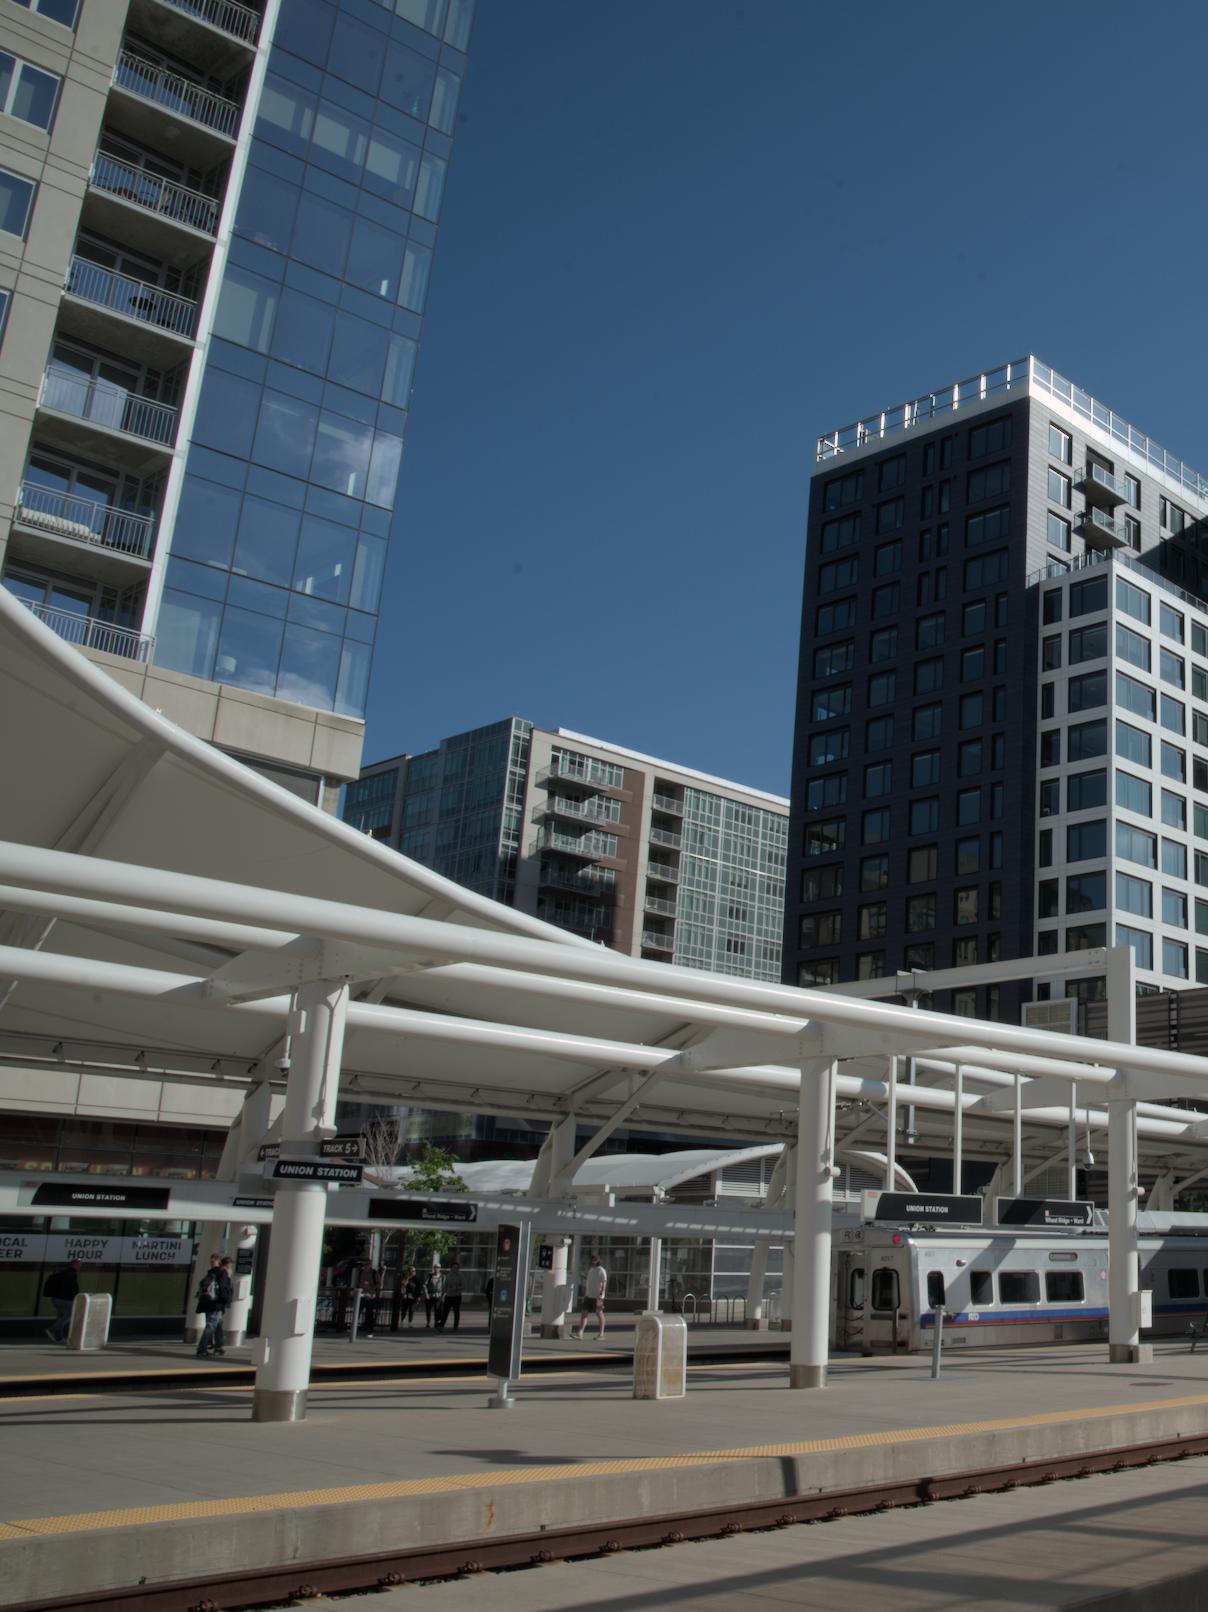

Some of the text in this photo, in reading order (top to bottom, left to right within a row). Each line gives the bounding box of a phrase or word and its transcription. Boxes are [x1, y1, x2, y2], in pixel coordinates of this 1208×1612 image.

[322, 1143, 351, 1154] TRACK 5
[280, 1164, 358, 1178] UNION STATION
[72, 1192, 126, 1201] UNION STATION
[906, 1204, 948, 1214] UNION STATION
[0, 1237, 28, 1247] CAL
[65, 1238, 109, 1249] HAPPY
[132, 1241, 182, 1250] MARTINI
[0, 1249, 23, 1259] EER
[67, 1249, 103, 1260] HOUR
[135, 1251, 176, 1261] LUNCH
